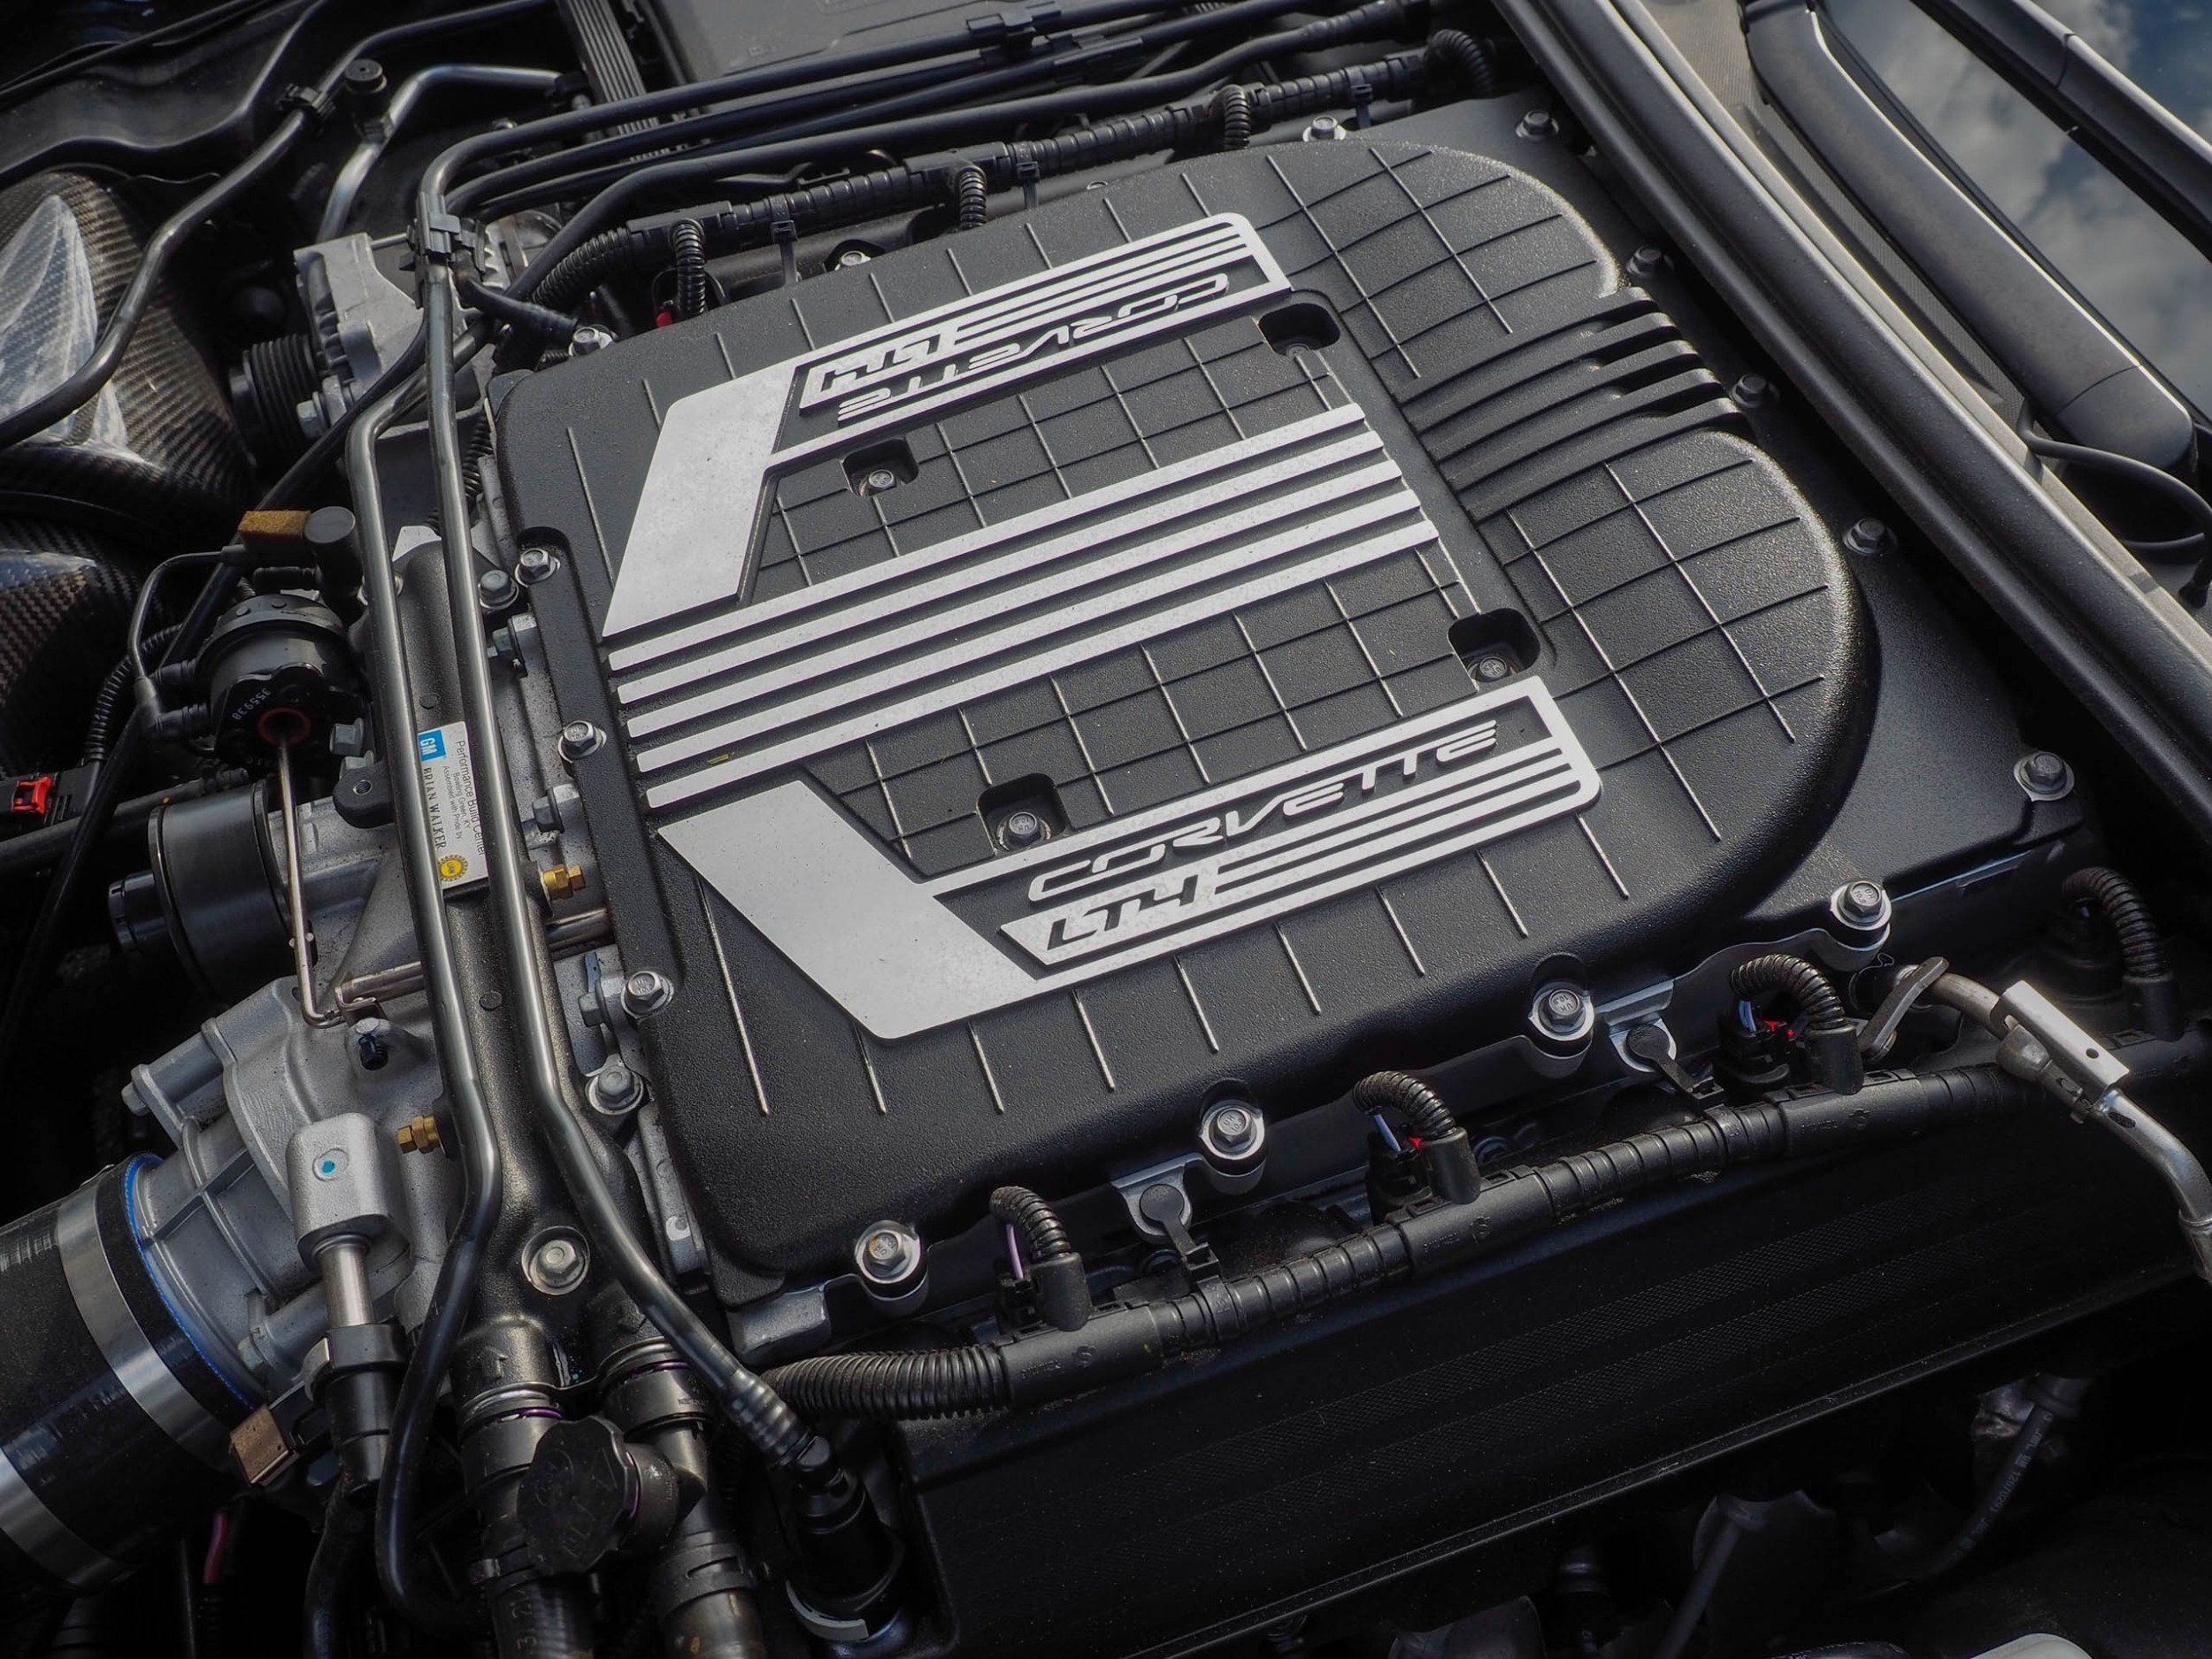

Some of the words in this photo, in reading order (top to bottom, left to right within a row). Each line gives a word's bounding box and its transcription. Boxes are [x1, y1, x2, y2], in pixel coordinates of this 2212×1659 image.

[821, 333, 942, 392] LT4
[838, 273, 1229, 422] CORVETTE
[420, 737, 437, 755] GM
[456, 740, 474, 797] Performance
[468, 798, 480, 822] Build
[423, 767, 436, 800] BRIAN
[430, 803, 447, 849] WALKER
[442, 765, 455, 798] Assembled
[452, 812, 461, 830] Pride
[1028, 719, 1498, 902] CORVETTE
[1047, 873, 1199, 950] LT4
